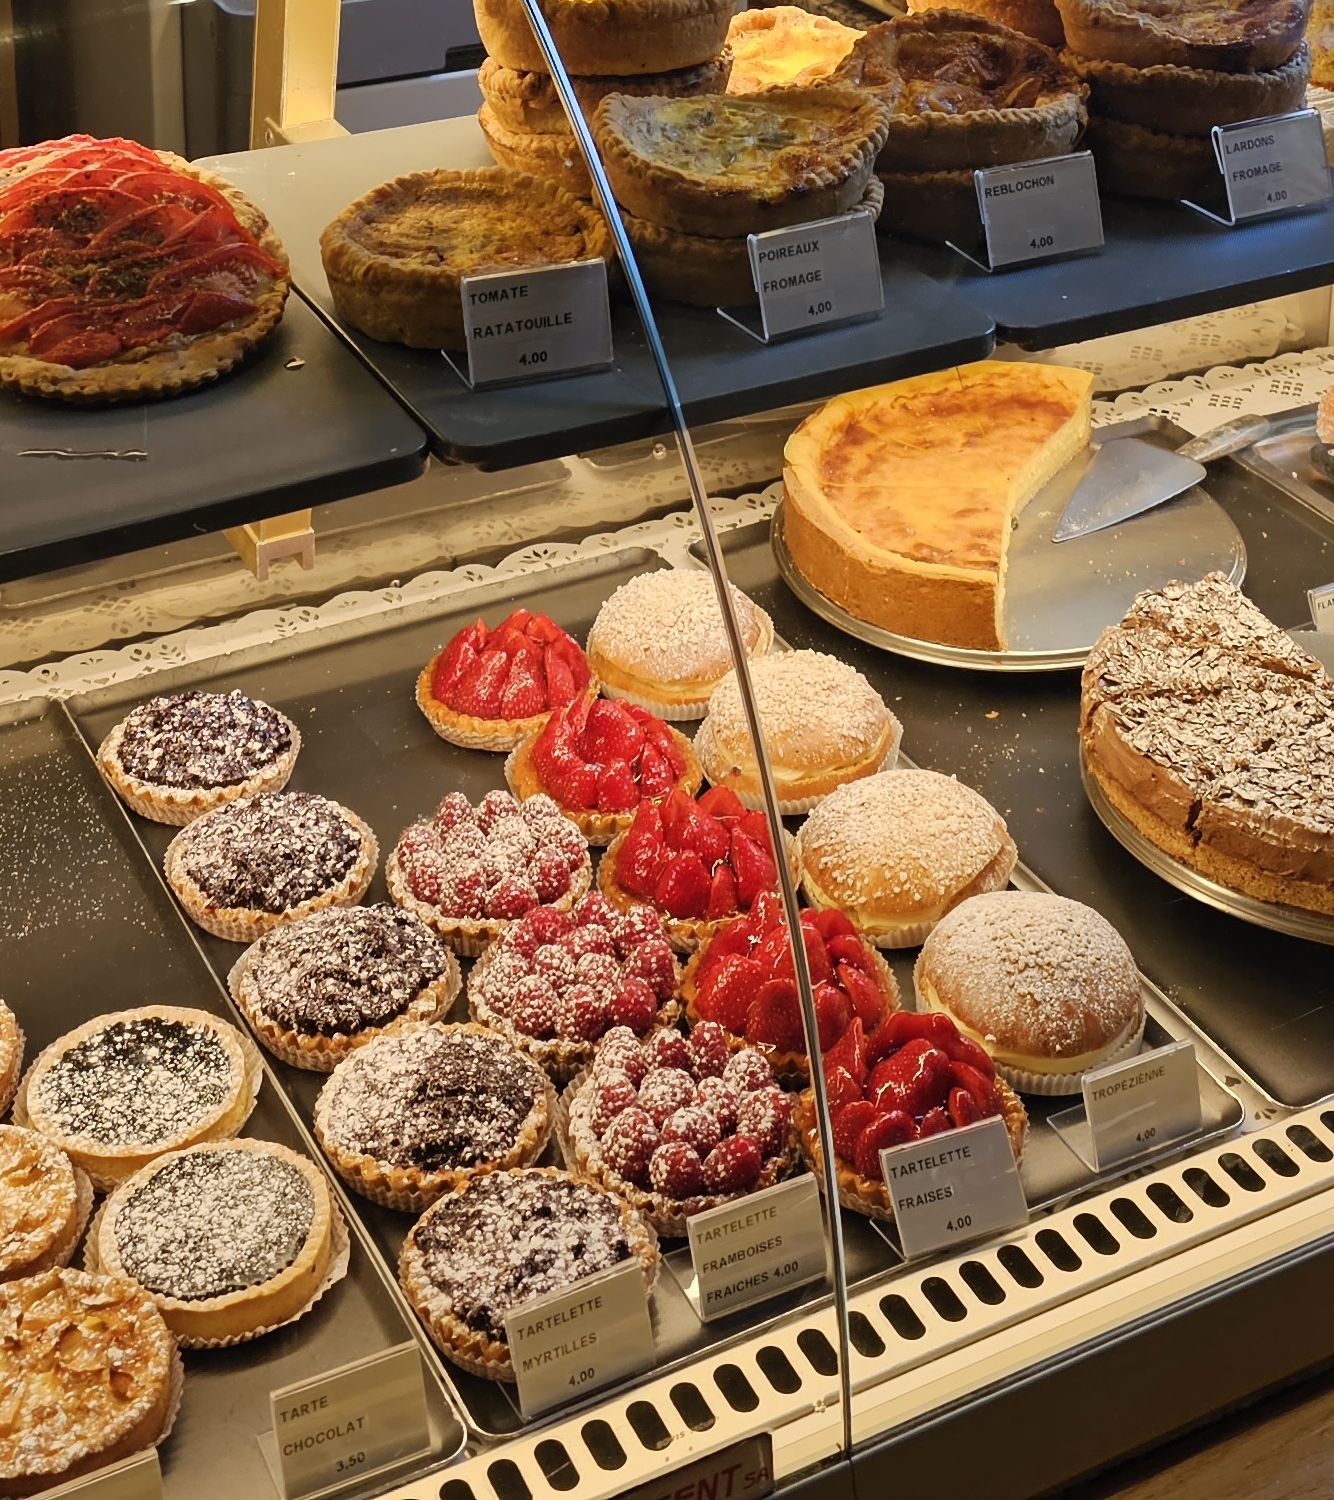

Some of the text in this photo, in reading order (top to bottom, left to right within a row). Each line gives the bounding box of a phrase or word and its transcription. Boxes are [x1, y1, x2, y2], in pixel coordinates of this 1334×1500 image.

[1225, 134, 1275, 154] LARDONS
[1232, 161, 1282, 182] FROMAGE
[984, 175, 1055, 198] REBLOCHON
[758, 240, 820, 263] POIREAUX
[763, 269, 822, 293] FROMAGE
[469, 285, 529, 306] TOMATE
[472, 312, 573, 339] RATATOUILLE
[890, 1145, 971, 1179] TARTELETTE
[898, 1186, 953, 1211] FRAISES
[696, 1206, 777, 1245] TARTELETTE
[703, 1235, 783, 1274] FRAMBOISES
[706, 1271, 769, 1303] FRAICHES
[517, 1296, 603, 1340] TARTELETTE
[522, 1332, 597, 1372] MYRTILLES
[280, 1395, 329, 1423] TARTE
[283, 1416, 365, 1456] CHOCOLAT
